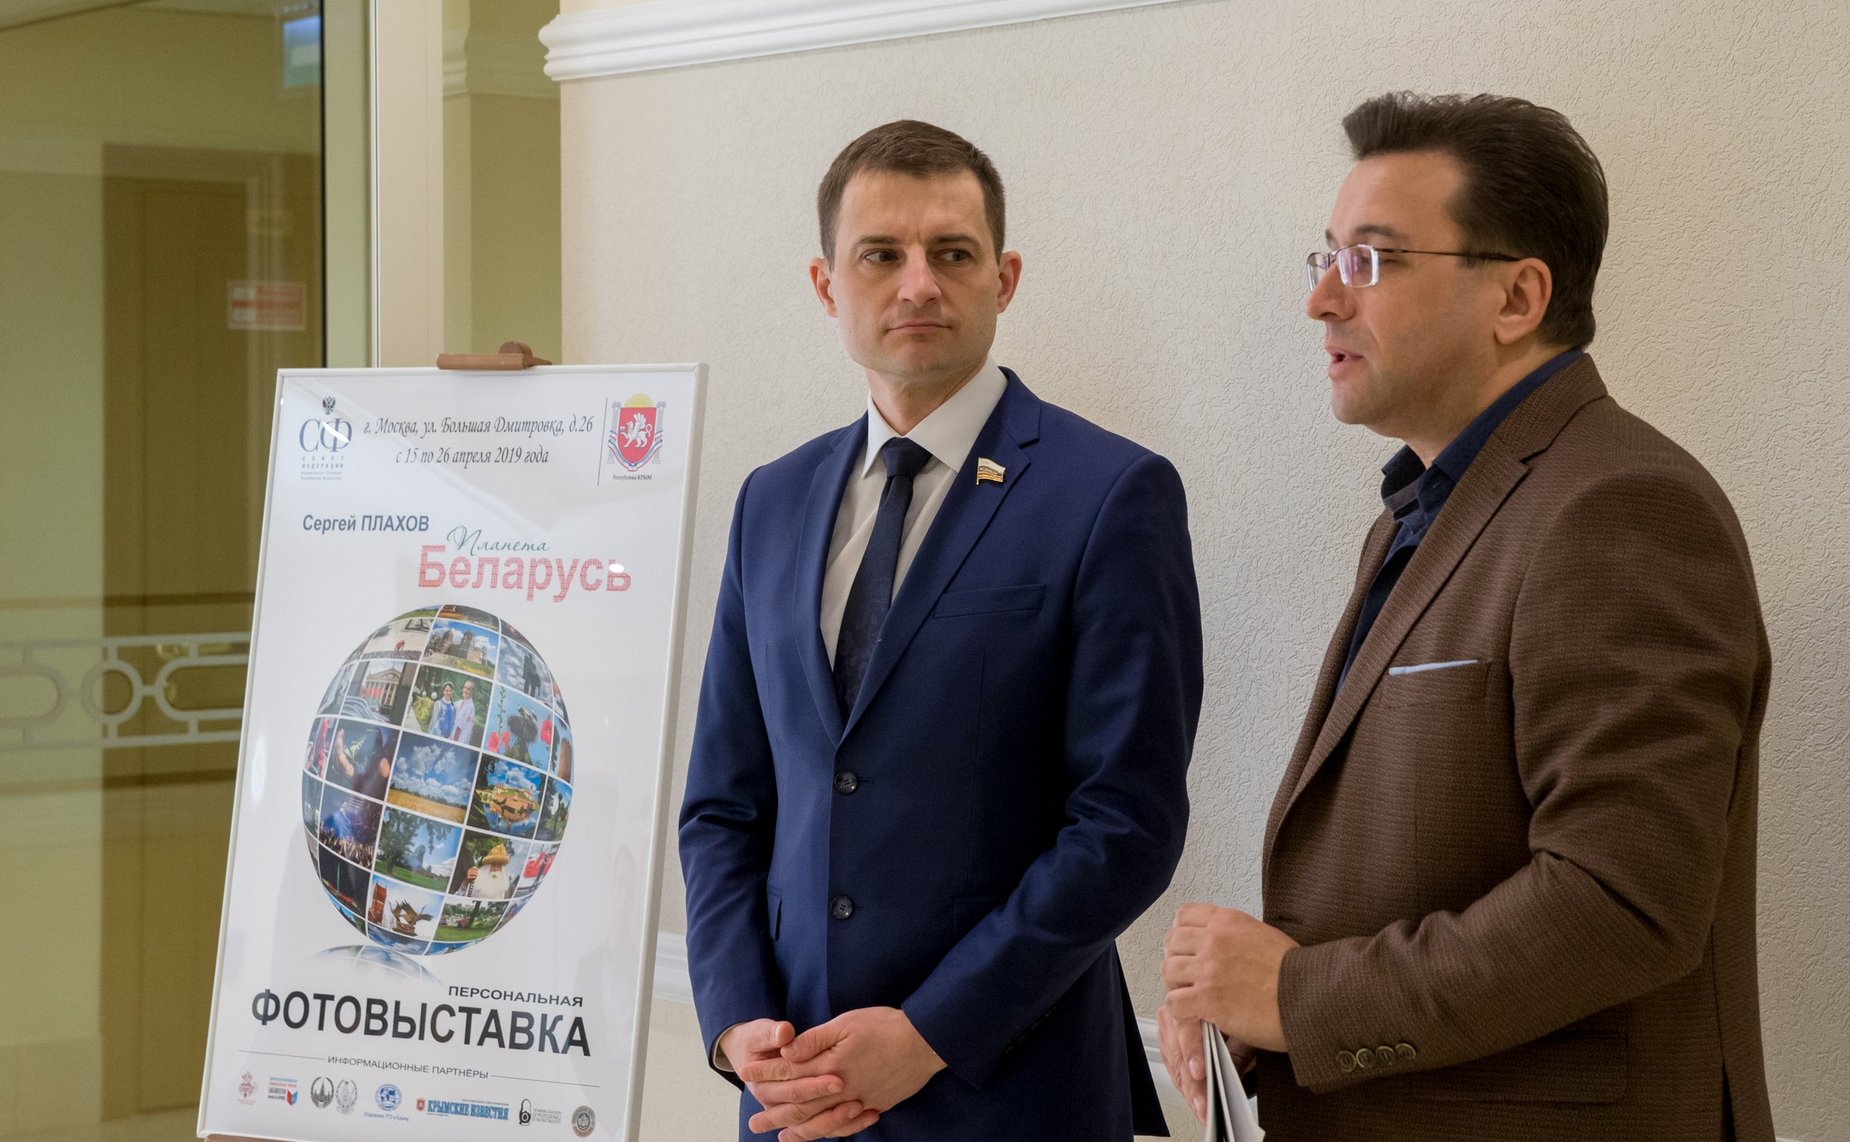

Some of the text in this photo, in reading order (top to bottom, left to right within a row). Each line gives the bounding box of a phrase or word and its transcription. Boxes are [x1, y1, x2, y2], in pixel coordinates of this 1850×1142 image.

[299, 417, 353, 452] СФ
[363, 413, 595, 439] г. Москва, ул. Большая Дмитровка, д.26
[395, 444, 549, 469] с 15 по 26 апреля 2019 года
[302, 514, 430, 535] Сергей ПЛАХОВ
[446, 525, 551, 557] Планета
[418, 544, 632, 603] Беларусь
[448, 985, 584, 1007] ПЕРСОНАЛЬНАЯ
[251, 988, 591, 1057] ФОТОВЫСТАВКА
[327, 1056, 430, 1074] ИНФОРМАЦИОННЫЕ
[427, 1099, 470, 1117] КРЫМСКИЕ
[469, 1103, 509, 1121] ИЗВЕСТИЯ
